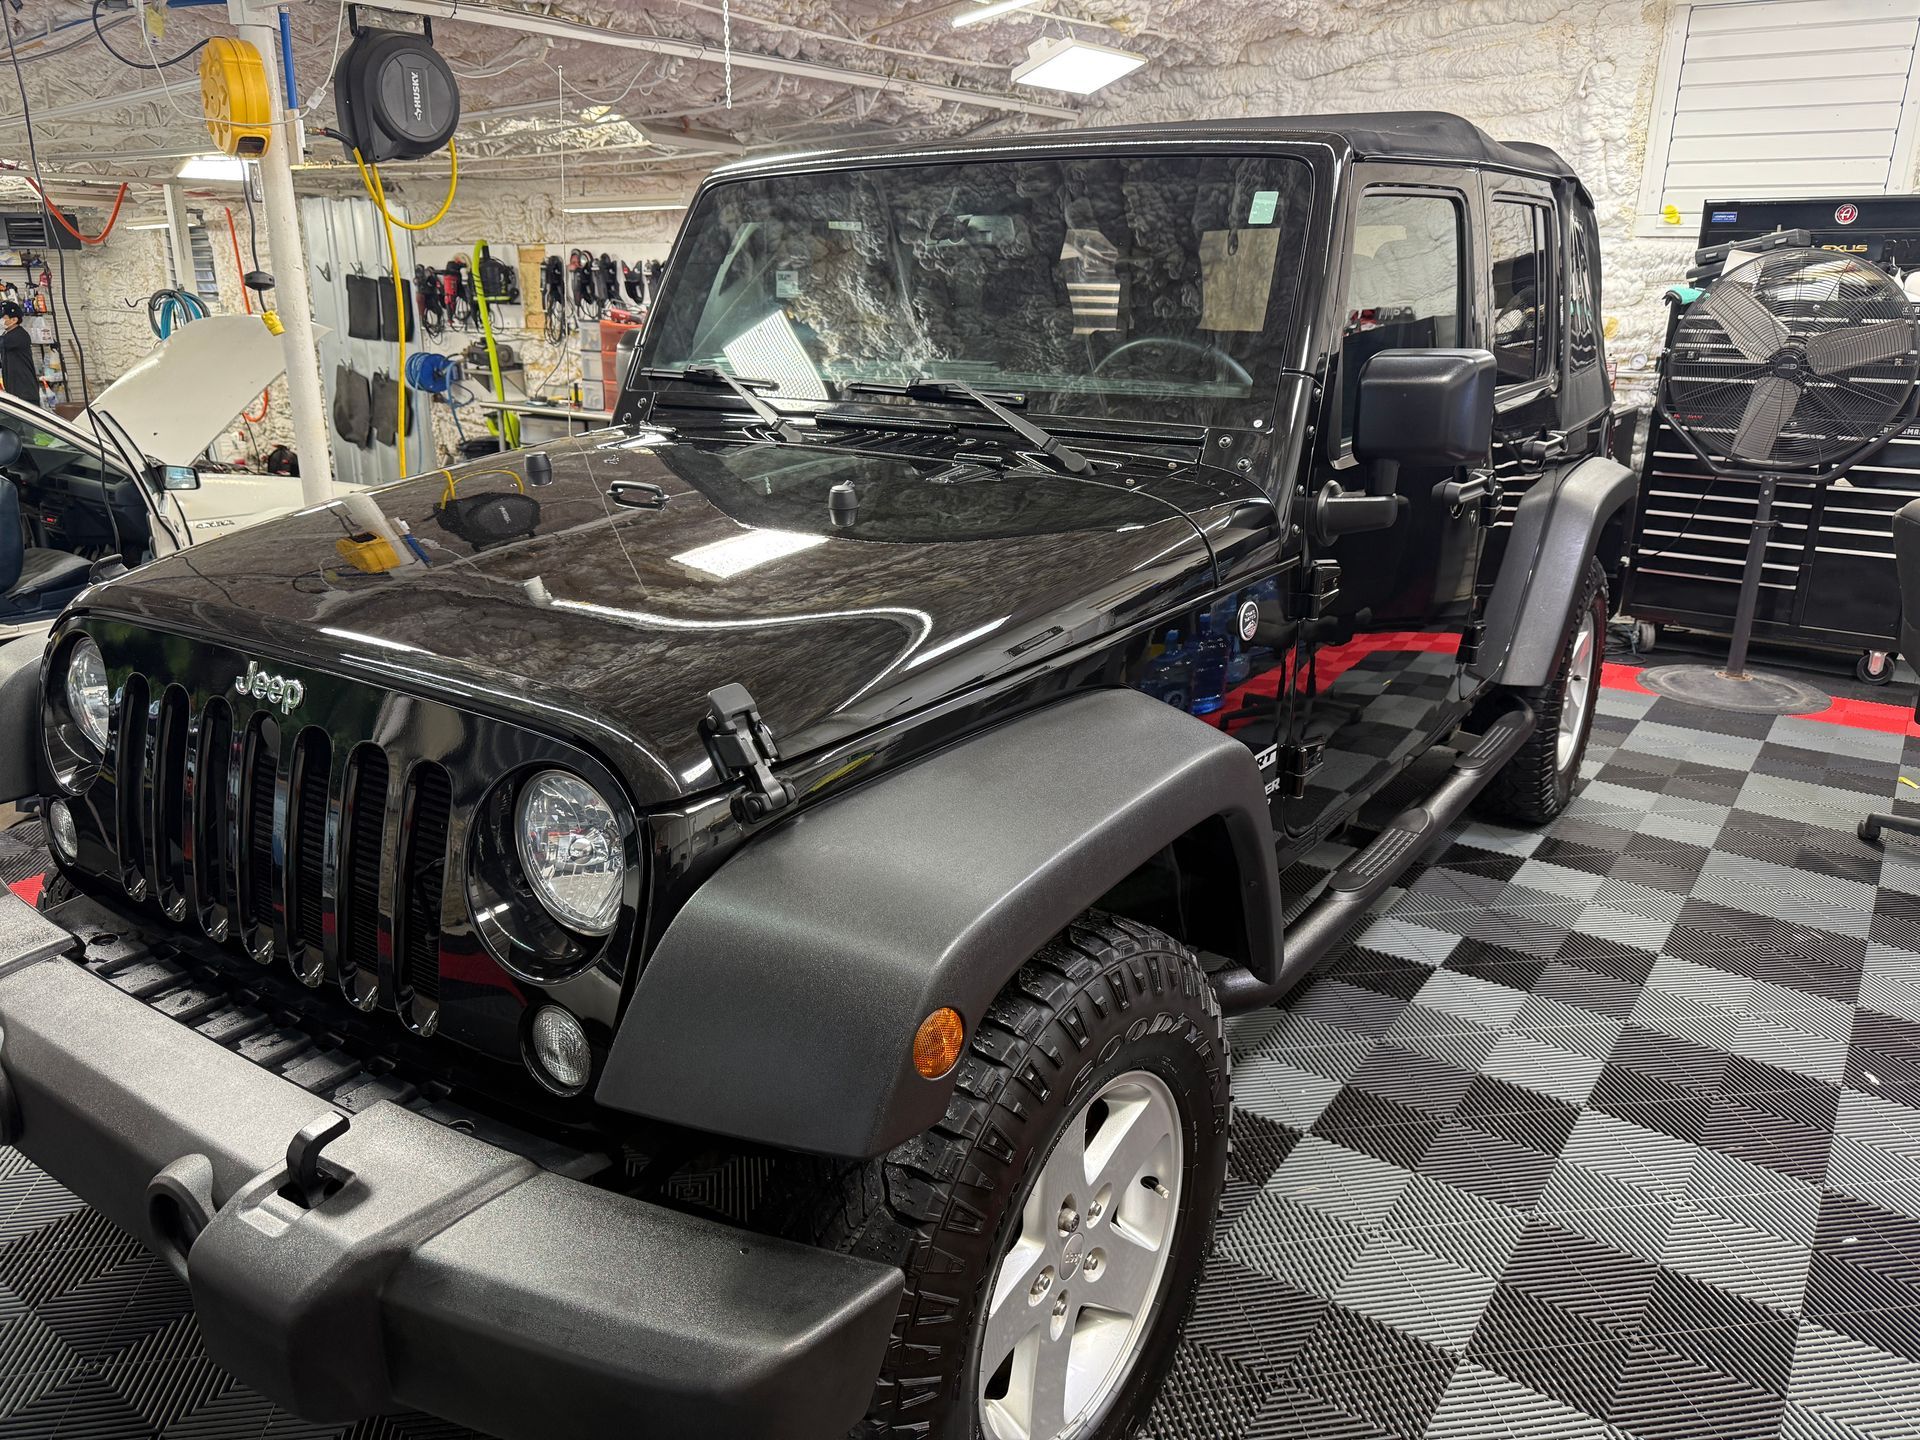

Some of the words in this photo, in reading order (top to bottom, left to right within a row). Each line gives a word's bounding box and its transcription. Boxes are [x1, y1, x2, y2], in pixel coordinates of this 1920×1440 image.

[410, 71, 422, 108] HUSKY
[1819, 244, 1868, 253] EXUS
[235, 660, 304, 716] Jeep
